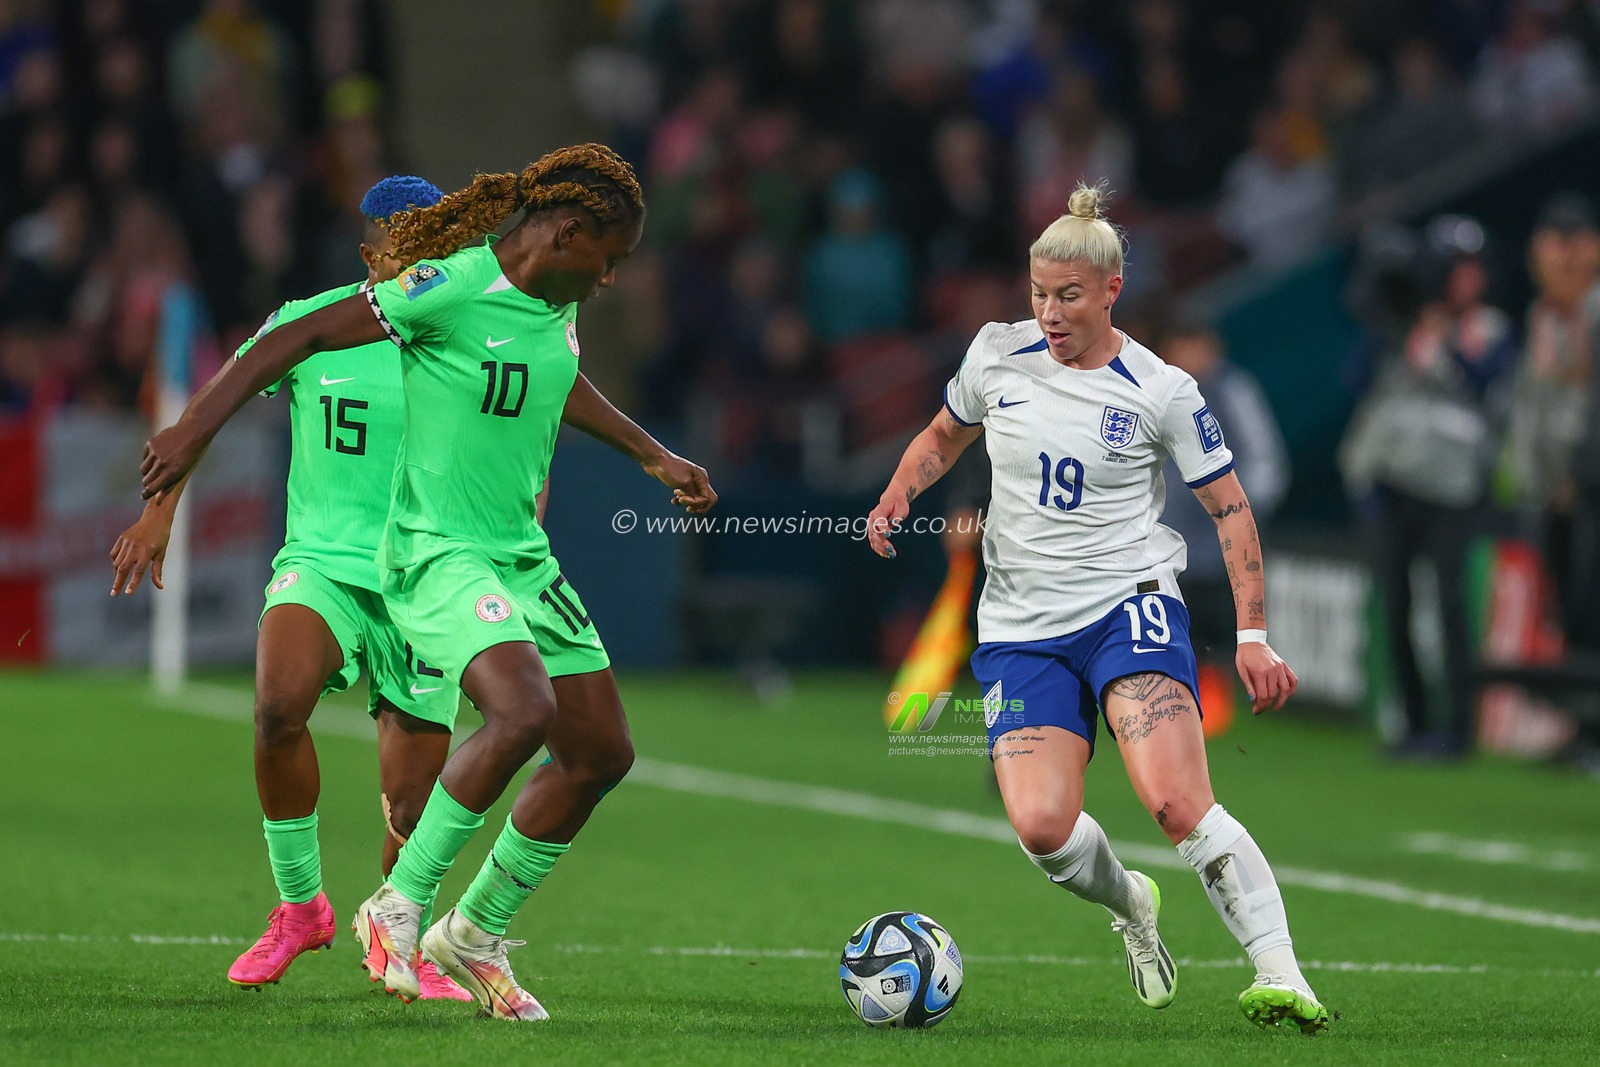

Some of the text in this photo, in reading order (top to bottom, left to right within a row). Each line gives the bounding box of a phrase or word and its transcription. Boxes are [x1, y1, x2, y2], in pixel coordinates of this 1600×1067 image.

[480, 361, 529, 418] 10
[319, 395, 369, 456] 15
[1038, 451, 1085, 512] 19
[1123, 595, 1171, 645] 19
